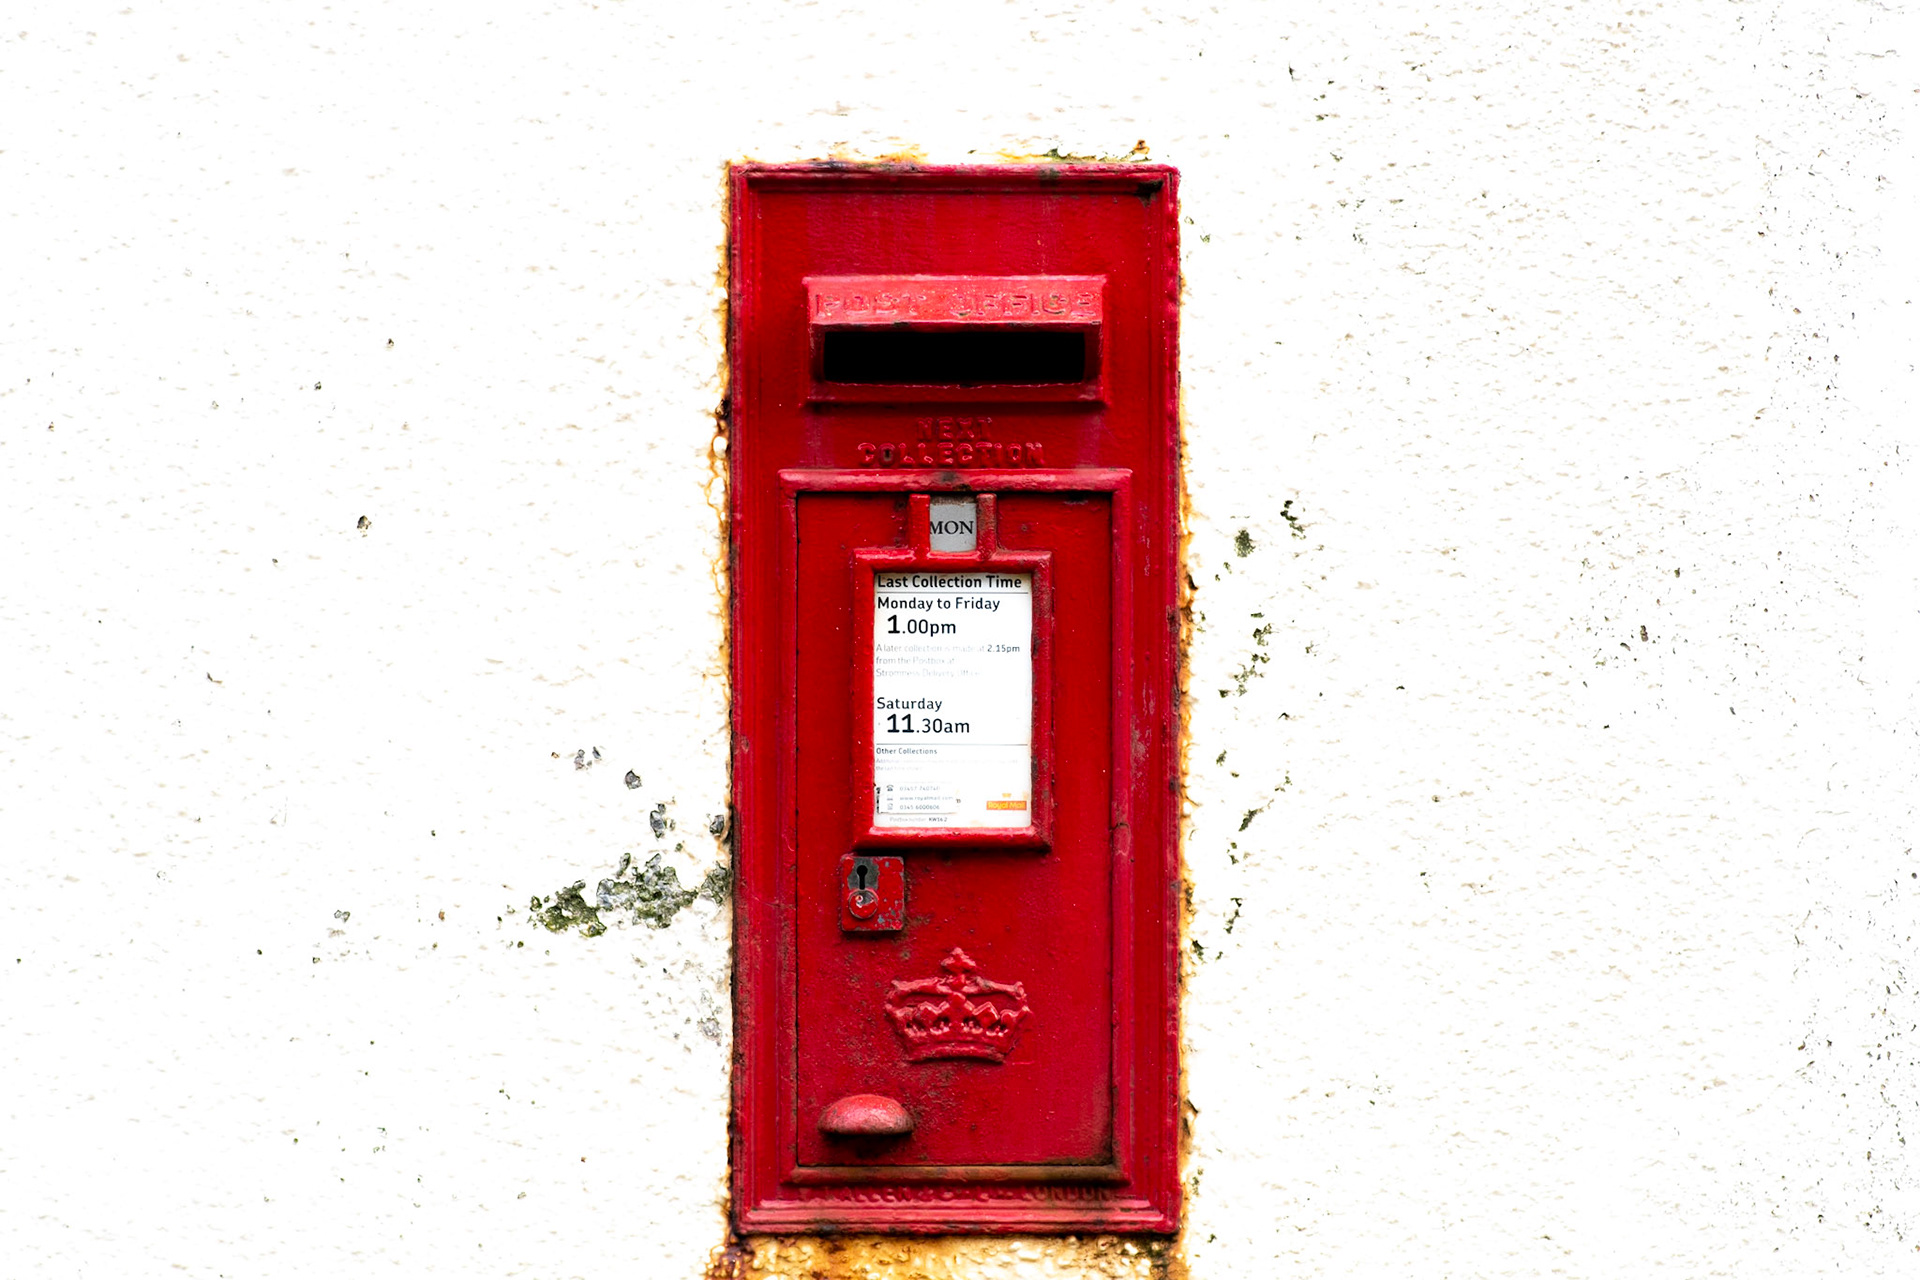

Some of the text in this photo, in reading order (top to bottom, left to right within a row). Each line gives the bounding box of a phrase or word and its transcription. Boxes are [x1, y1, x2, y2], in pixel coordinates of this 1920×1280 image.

[815, 291, 1095, 317] POST OFFICE
[915, 416, 992, 441] NEXT
[857, 441, 1044, 466] COLLECTION
[929, 521, 975, 535] MON
[877, 575, 1022, 588] Last Collection Time
[877, 597, 1001, 612] Monday to Friday
[887, 614, 956, 637] 1.00pm
[876, 644, 881, 652] A
[884, 644, 902, 652] later
[987, 644, 1020, 653] 2.15pm
[876, 656, 896, 664] from
[898, 656, 911, 664] the
[877, 697, 942, 712] Saturday
[887, 713, 970, 735] 11.30am
[876, 747, 938, 755] Other Collections
[988, 801, 1008, 810] Royal
